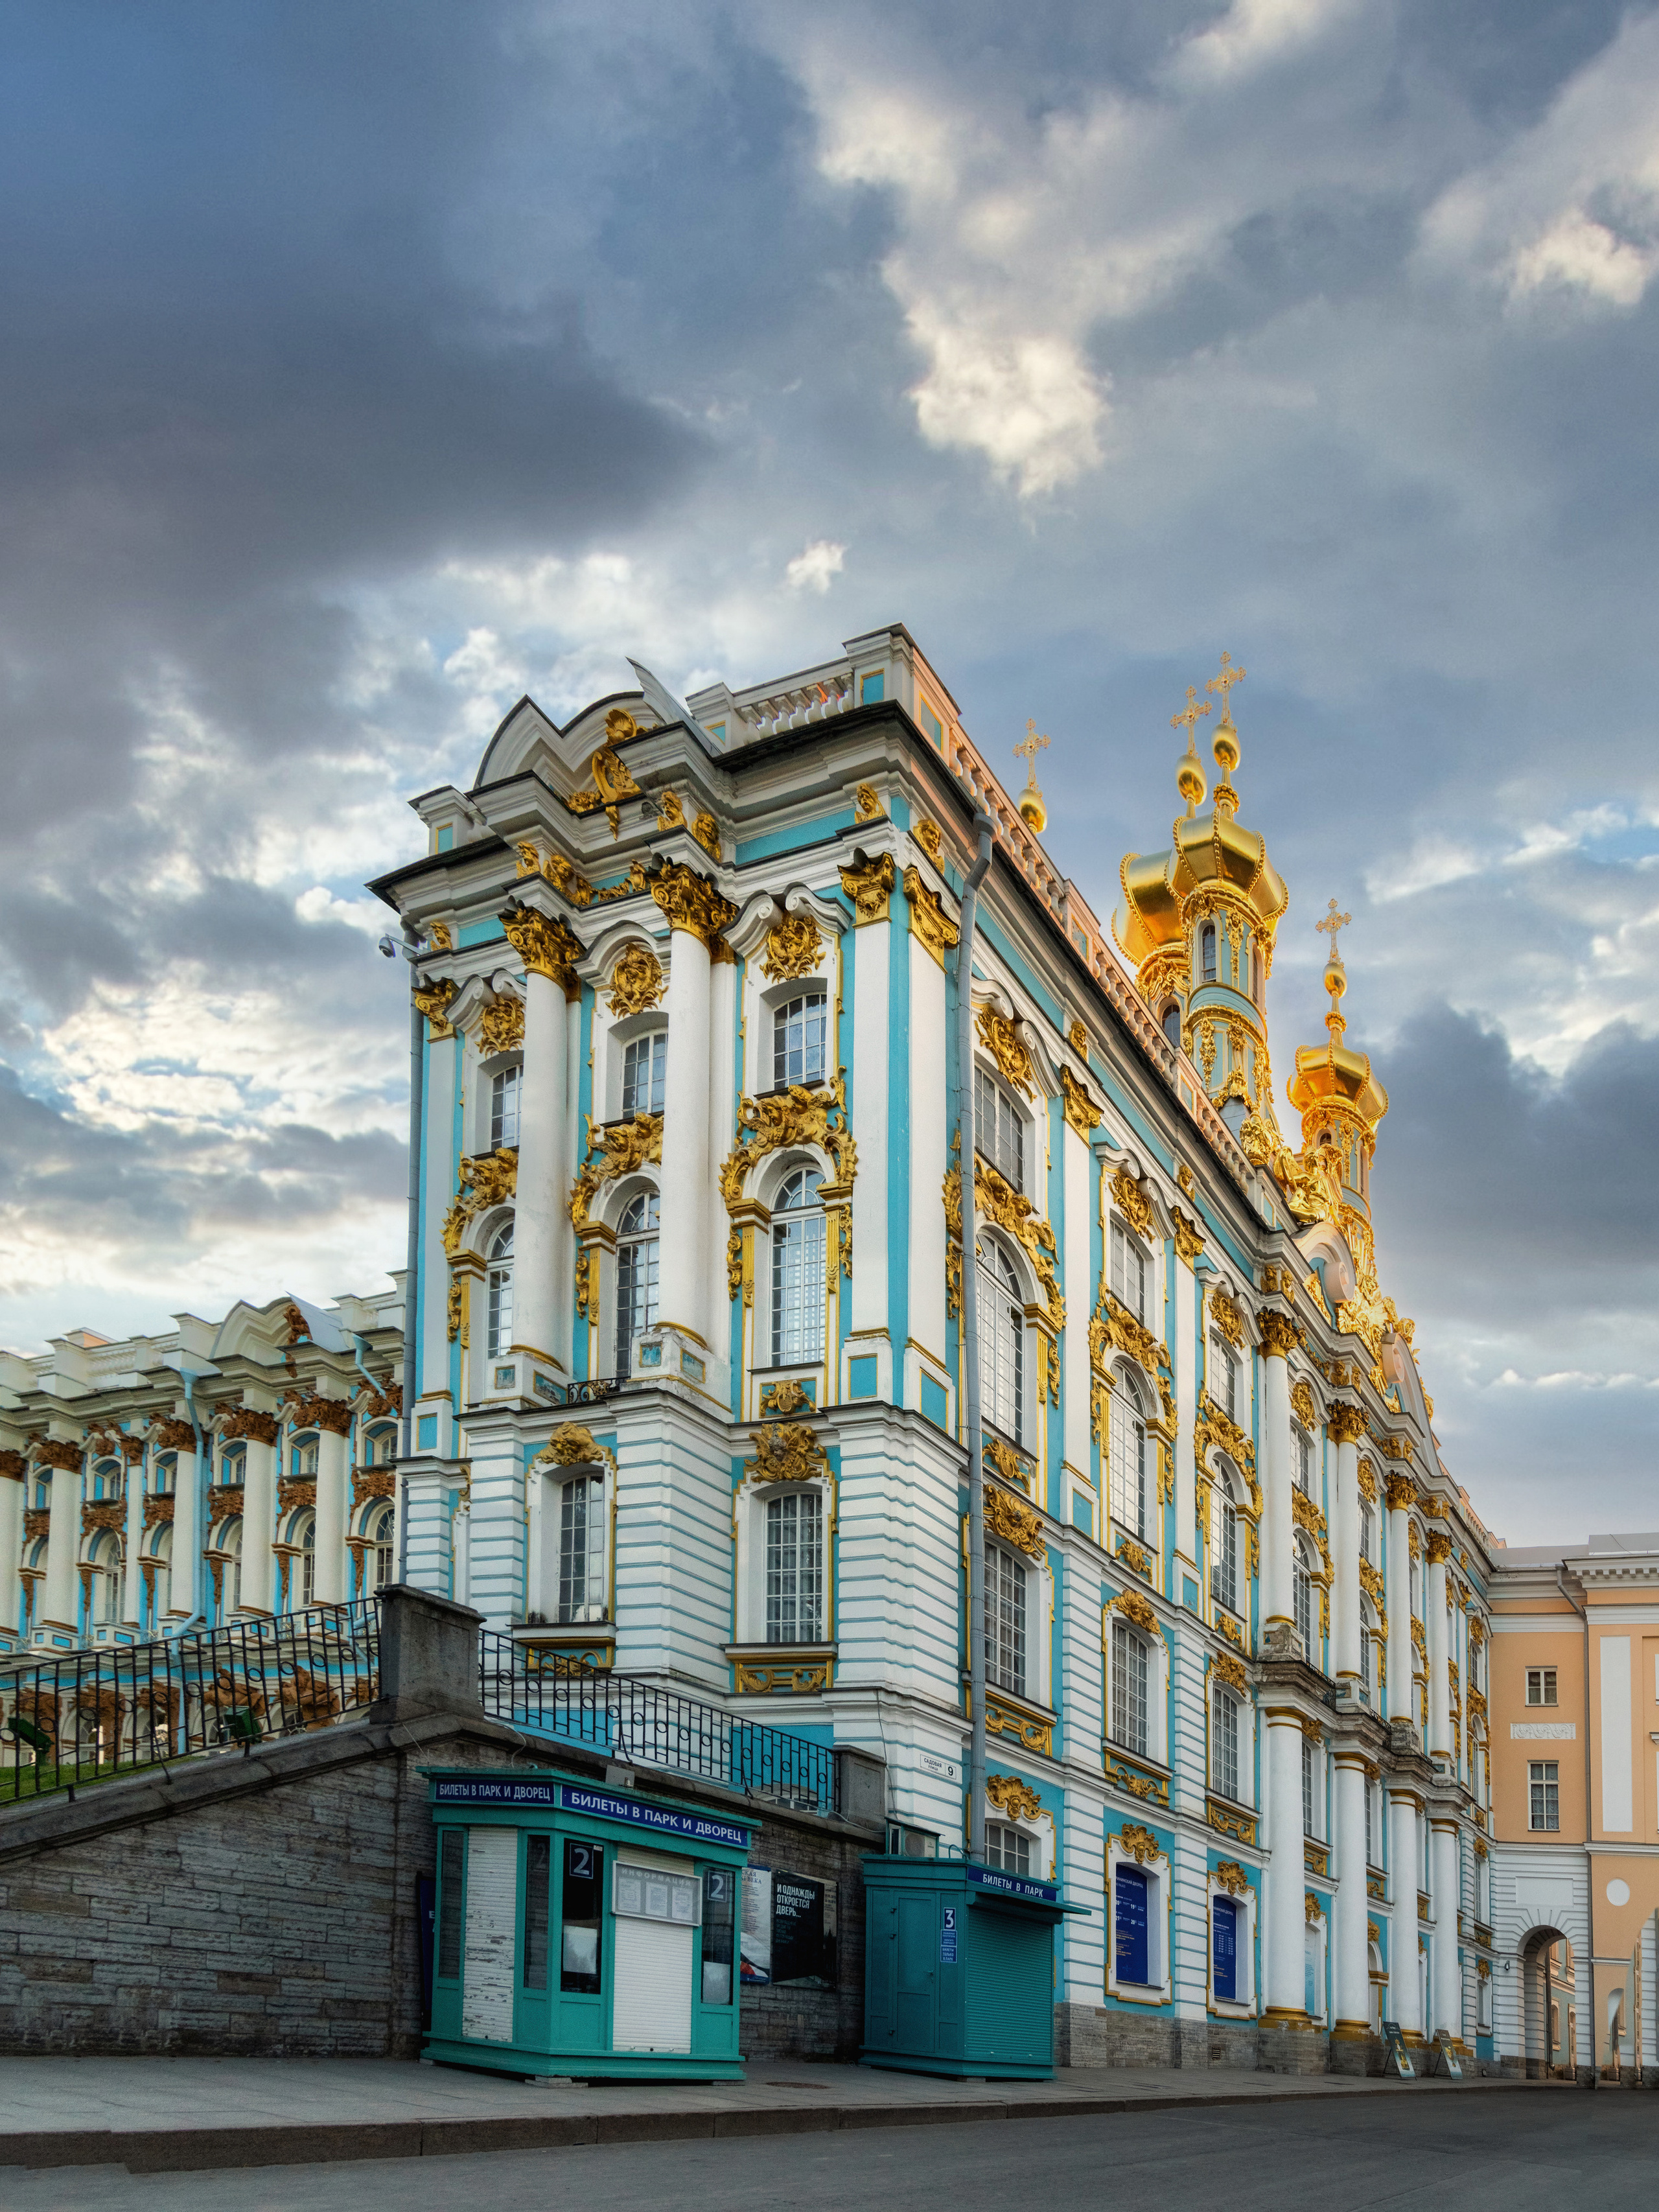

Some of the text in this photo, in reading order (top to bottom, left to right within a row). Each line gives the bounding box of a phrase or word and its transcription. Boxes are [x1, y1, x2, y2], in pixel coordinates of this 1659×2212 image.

[924, 1758, 942, 1767] САДОВАЯ
[947, 1766, 953, 1776] 9
[439, 1784, 550, 1801] БИЛЕТЫ В ПАРК И ДВОРЕЦ
[571, 1792, 741, 1843] БИЛЕТЫ В ПАРК И ДВОРЕЦ
[574, 1848, 589, 1875] 2
[621, 1867, 691, 1886] ИНФОРМАЦИЯ
[711, 1875, 724, 1899] 2
[777, 1883, 815, 1900] И ОДНАЖДЫ
[982, 1874, 1043, 1898] БИЛЕТЫ В ПАРК
[776, 1894, 810, 1909] ОТКРОЕТСЯ
[776, 1905, 802, 1918] ДВЕРЬ...
[946, 1909, 954, 1928] 3
